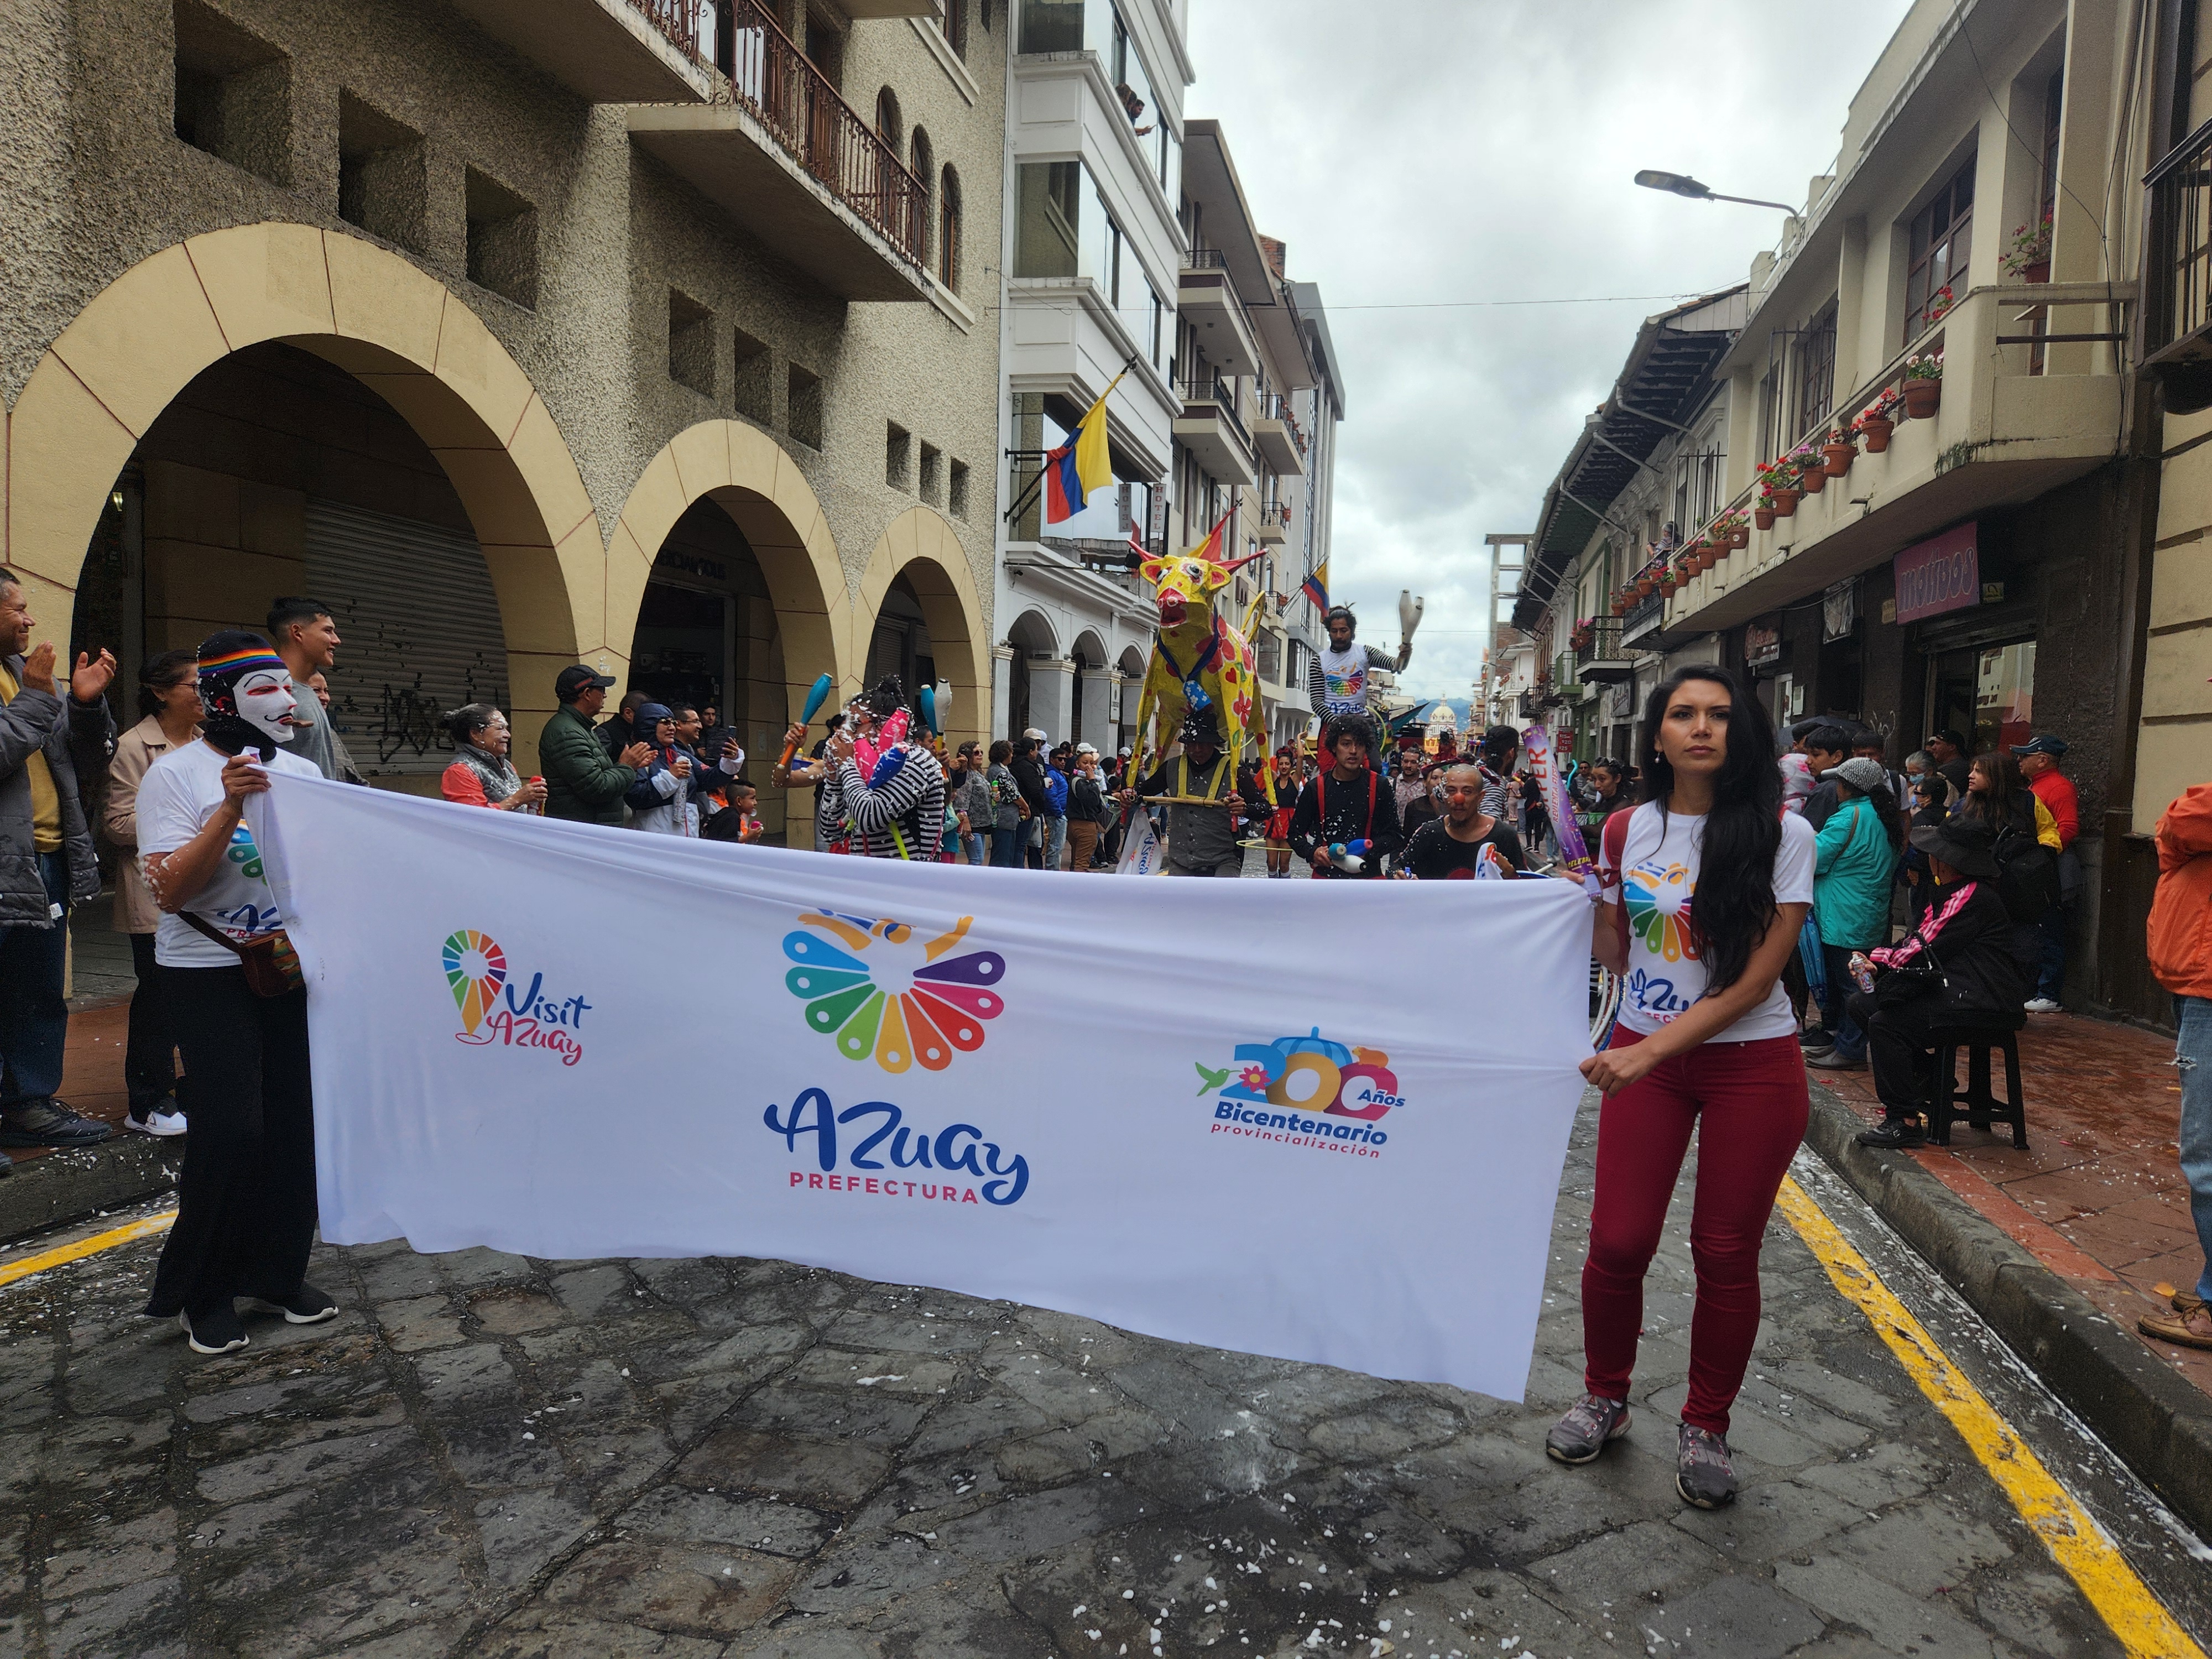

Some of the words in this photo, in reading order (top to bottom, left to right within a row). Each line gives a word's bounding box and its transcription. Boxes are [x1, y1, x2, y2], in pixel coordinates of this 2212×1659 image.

[1154, 487, 1164, 529] HOTEL
[505, 972, 593, 1029] Visit
[1219, 1043, 1399, 1121] 200
[1357, 1089, 1406, 1107] Años
[1211, 1123, 1380, 1159] provincialización
[1214, 1101, 1388, 1145] Bicentenario
[789, 1172, 979, 1204] PREFECTURA
